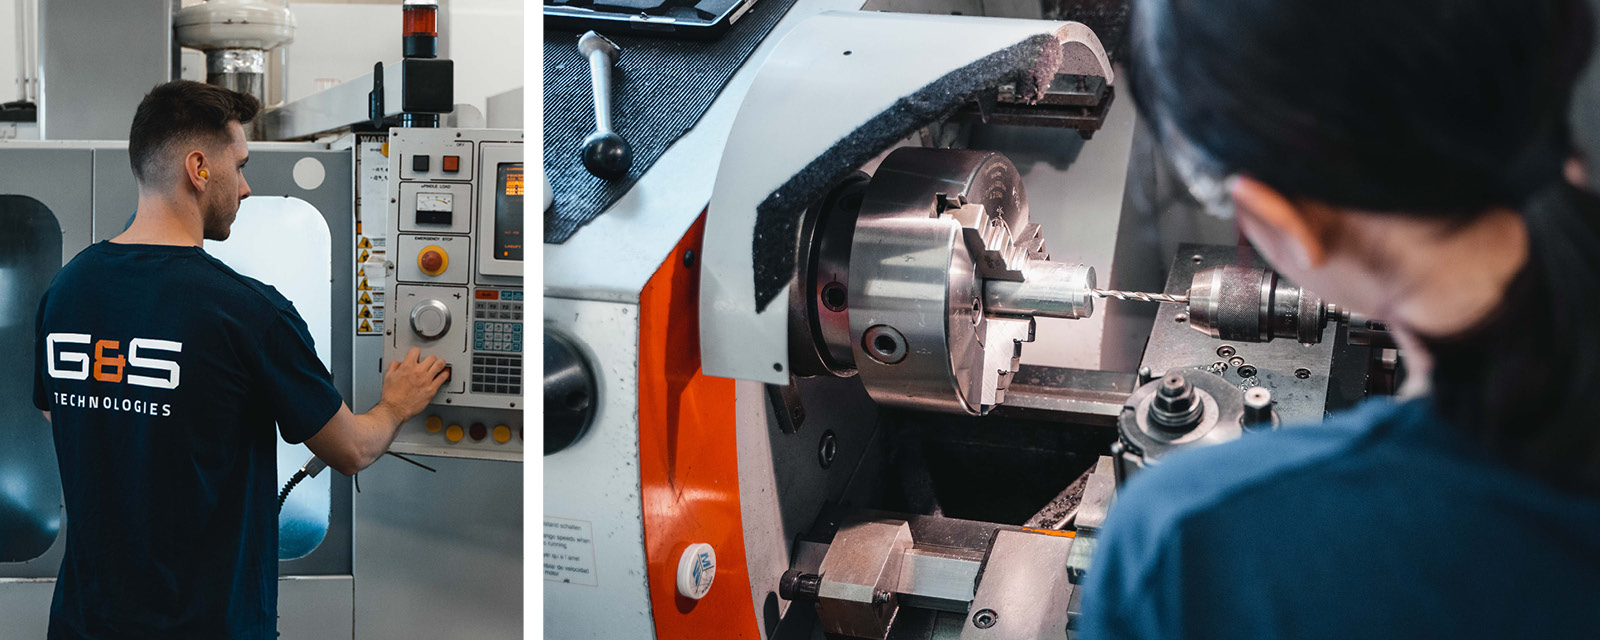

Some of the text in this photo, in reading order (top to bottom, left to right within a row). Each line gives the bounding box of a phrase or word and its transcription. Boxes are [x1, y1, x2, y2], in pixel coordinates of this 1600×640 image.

[46, 333, 183, 390] G&S
[54, 392, 171, 417] TECHNOLOGIES
[547, 541, 568, 550] running
